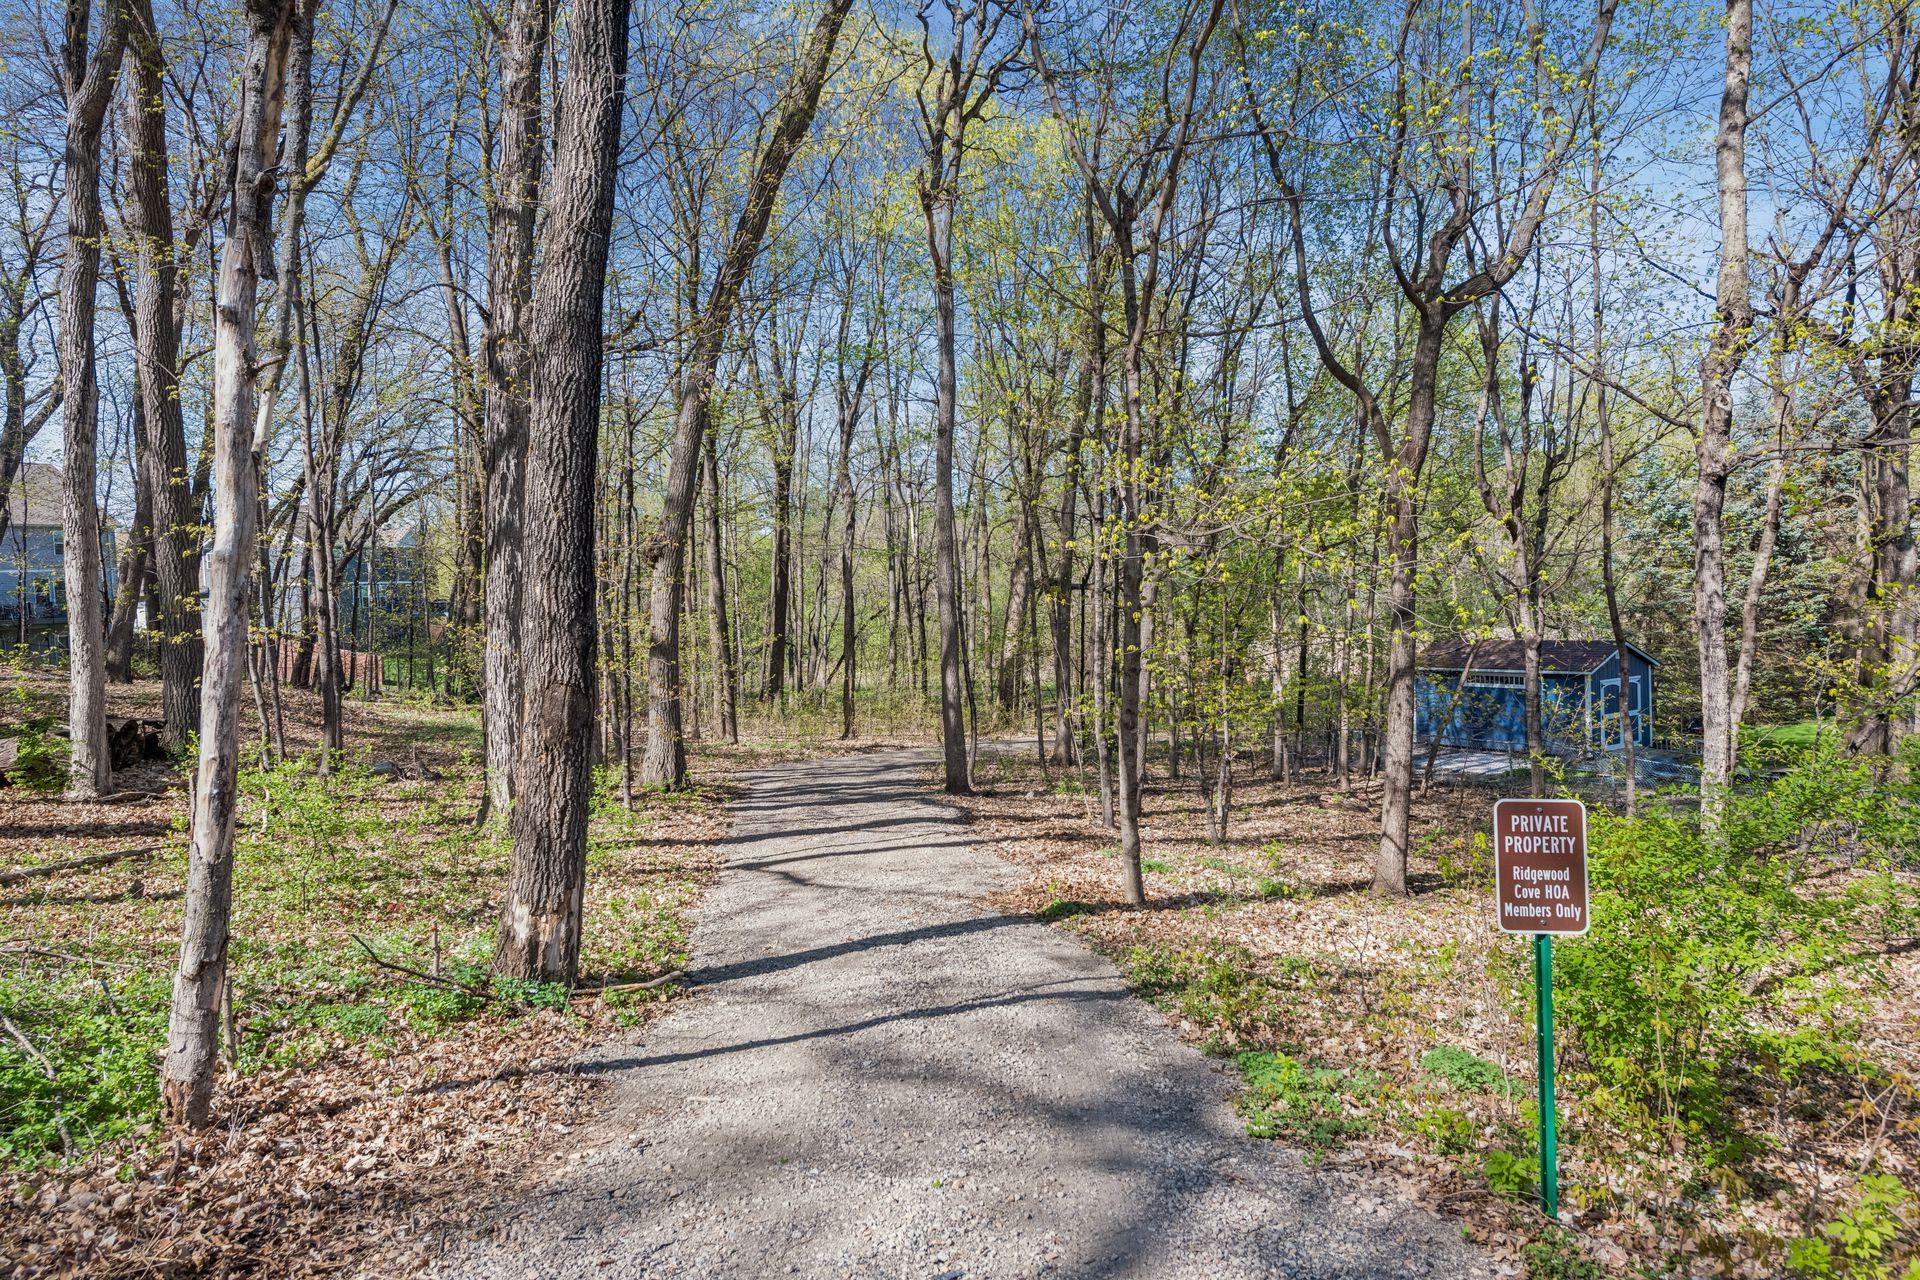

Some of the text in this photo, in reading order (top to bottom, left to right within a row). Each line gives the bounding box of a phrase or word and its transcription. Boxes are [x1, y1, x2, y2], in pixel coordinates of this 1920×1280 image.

[1511, 815, 1569, 833] PRIVATE
[1505, 836, 1576, 854] PROPERTY
[1513, 866, 1570, 884] Ridgewood
[1514, 884, 1570, 899] Cove HOA
[1505, 902, 1581, 921] Members Only
